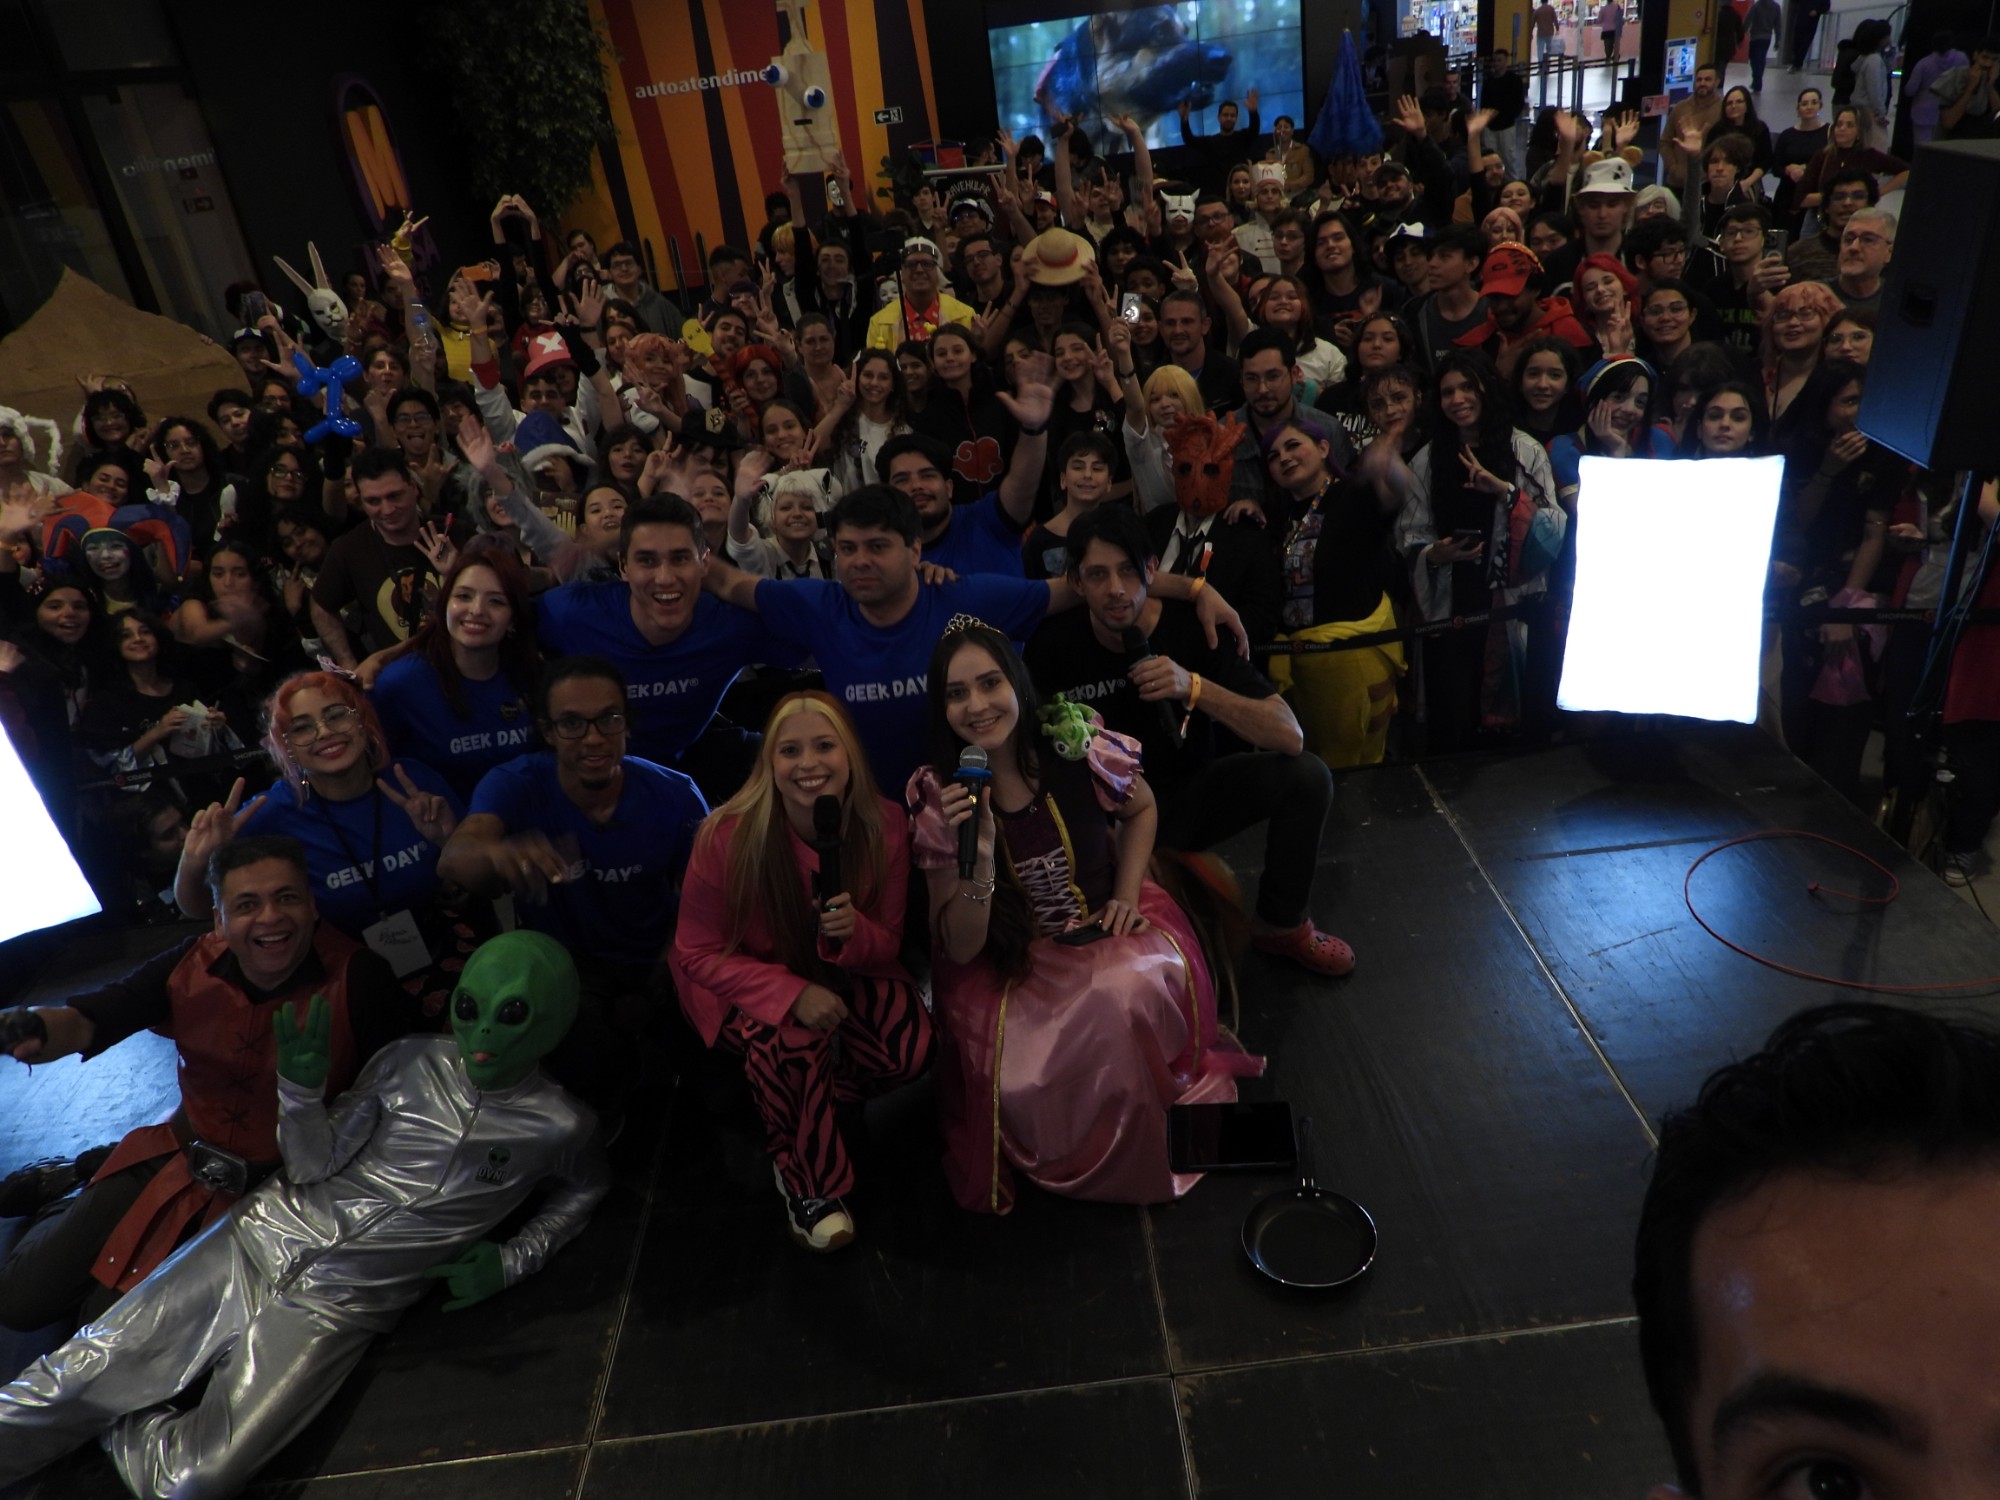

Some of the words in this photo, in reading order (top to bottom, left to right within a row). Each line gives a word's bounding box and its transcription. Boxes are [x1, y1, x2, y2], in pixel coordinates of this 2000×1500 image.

[626, 683, 650, 699] EK
[845, 682, 891, 702] GEEK
[450, 732, 491, 754] GEEK
